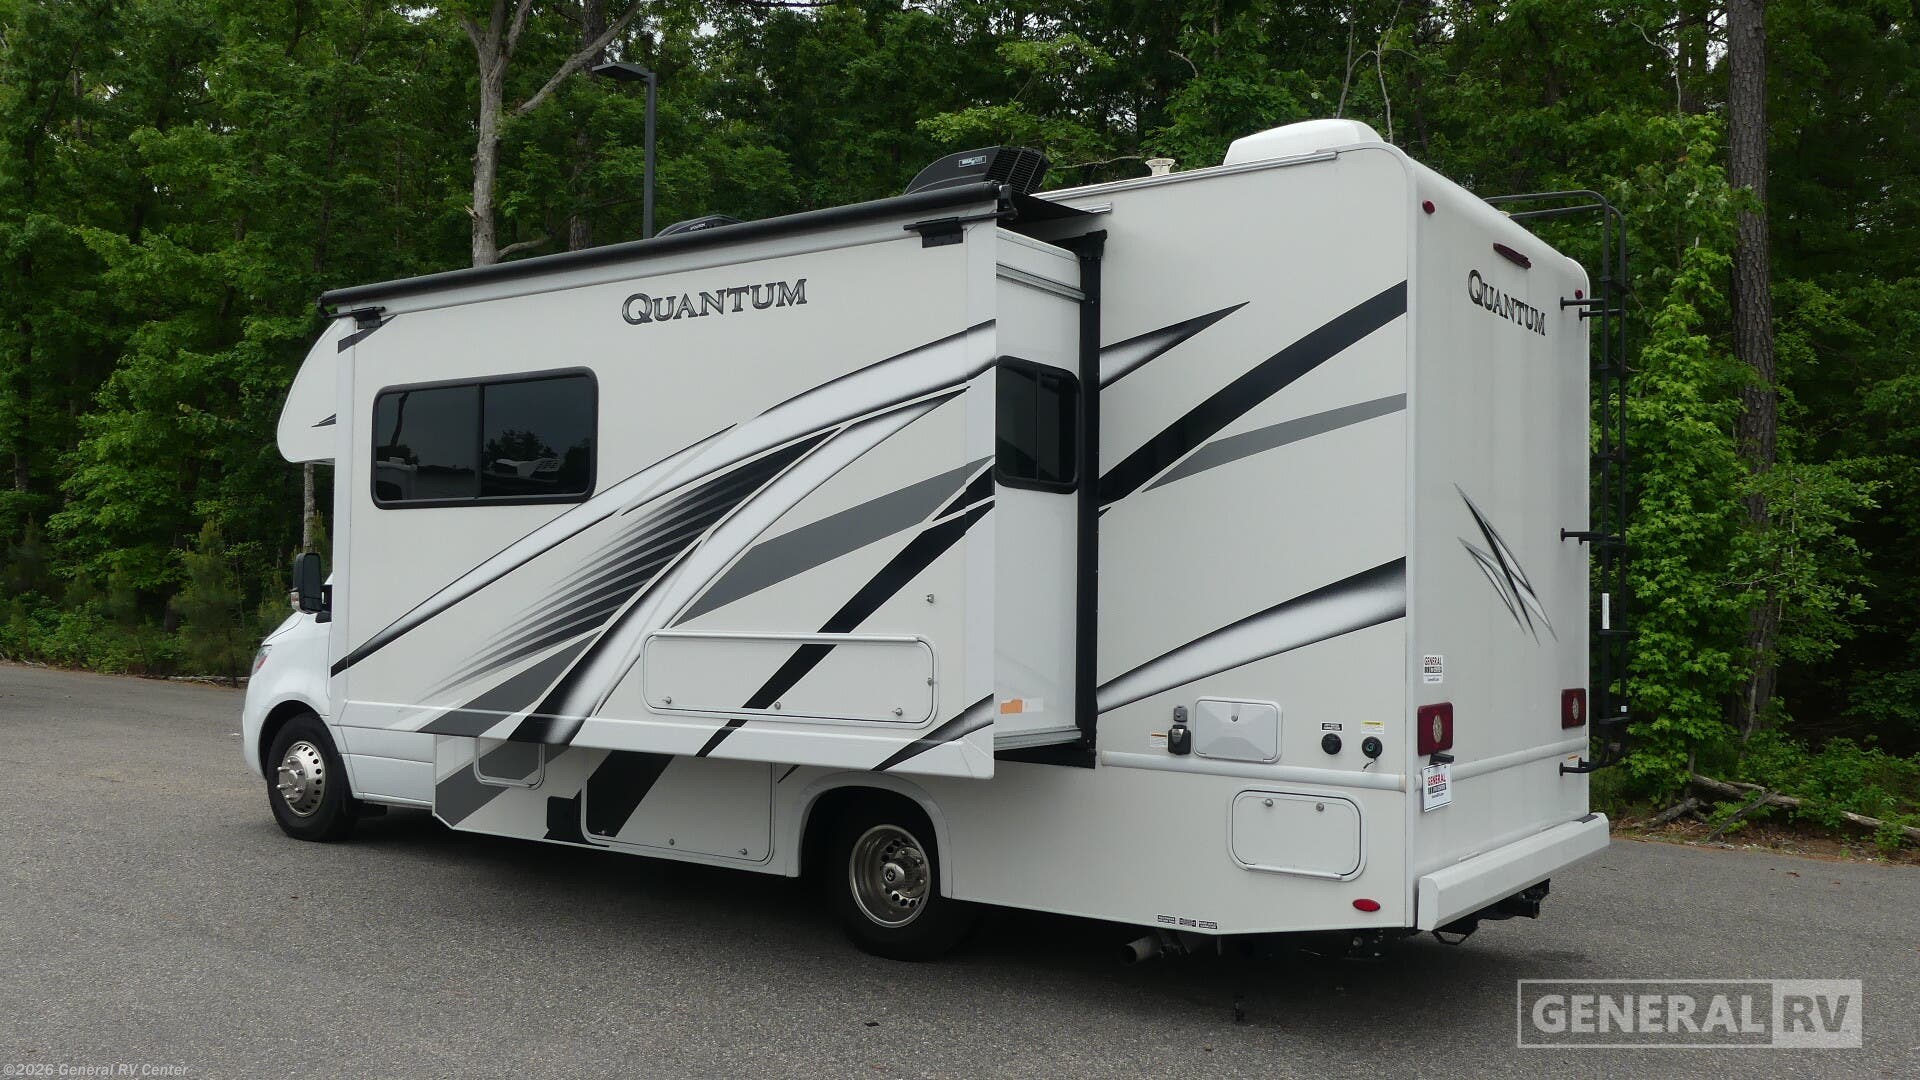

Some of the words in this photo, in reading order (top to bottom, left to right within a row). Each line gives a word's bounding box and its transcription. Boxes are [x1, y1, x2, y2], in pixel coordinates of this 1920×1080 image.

[621, 278, 807, 326] QUANTUM
[1467, 269, 1546, 336] QUANTUM
[1424, 656, 1442, 666] GENERAL
[1427, 773, 1447, 787] GENERAL
